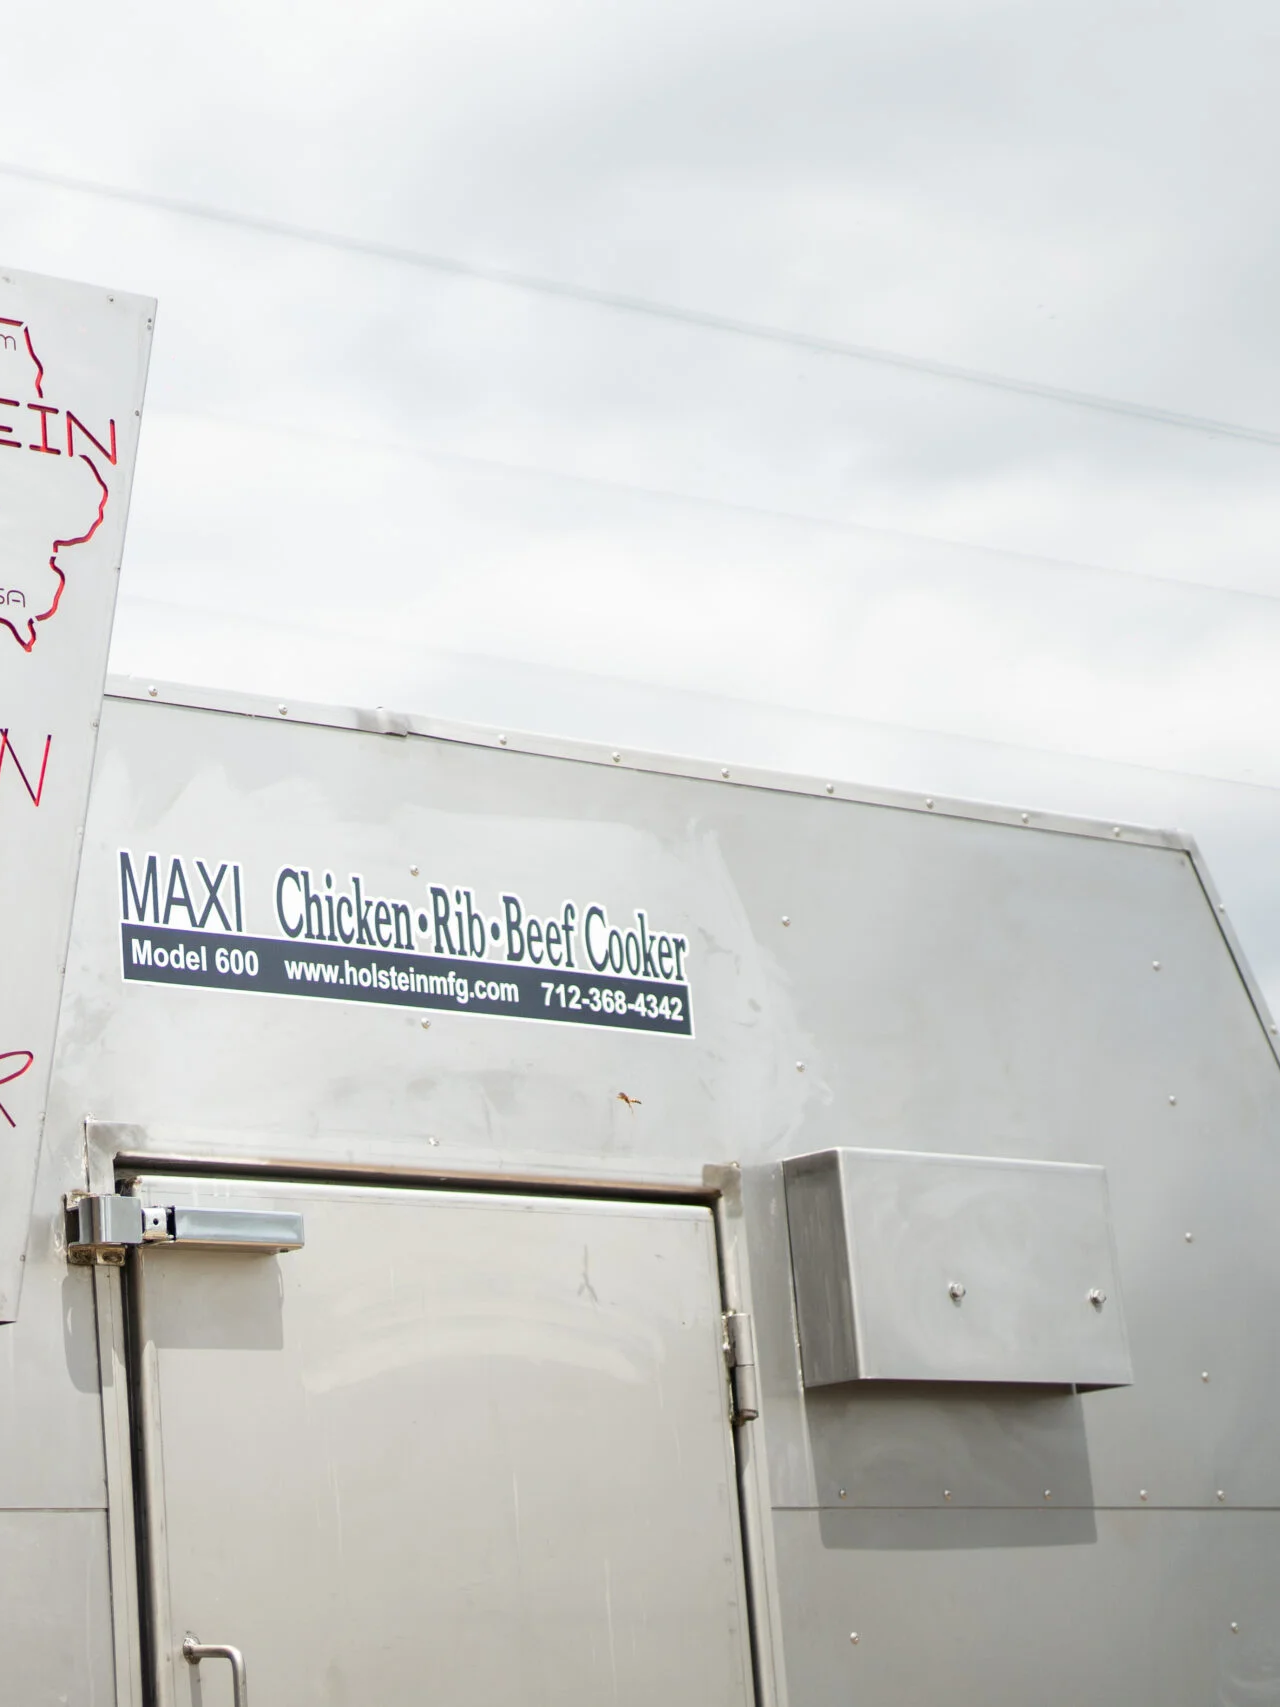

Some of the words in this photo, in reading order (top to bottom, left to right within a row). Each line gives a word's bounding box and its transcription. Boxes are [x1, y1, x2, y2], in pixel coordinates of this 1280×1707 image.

[119, 851, 244, 933] MAXI
[584, 906, 689, 983] Cooker
[130, 938, 208, 974] Model
[214, 946, 260, 977] 600
[284, 956, 520, 1004] www.holsteinmfg.com
[540, 981, 684, 1022] 712-368-4342
